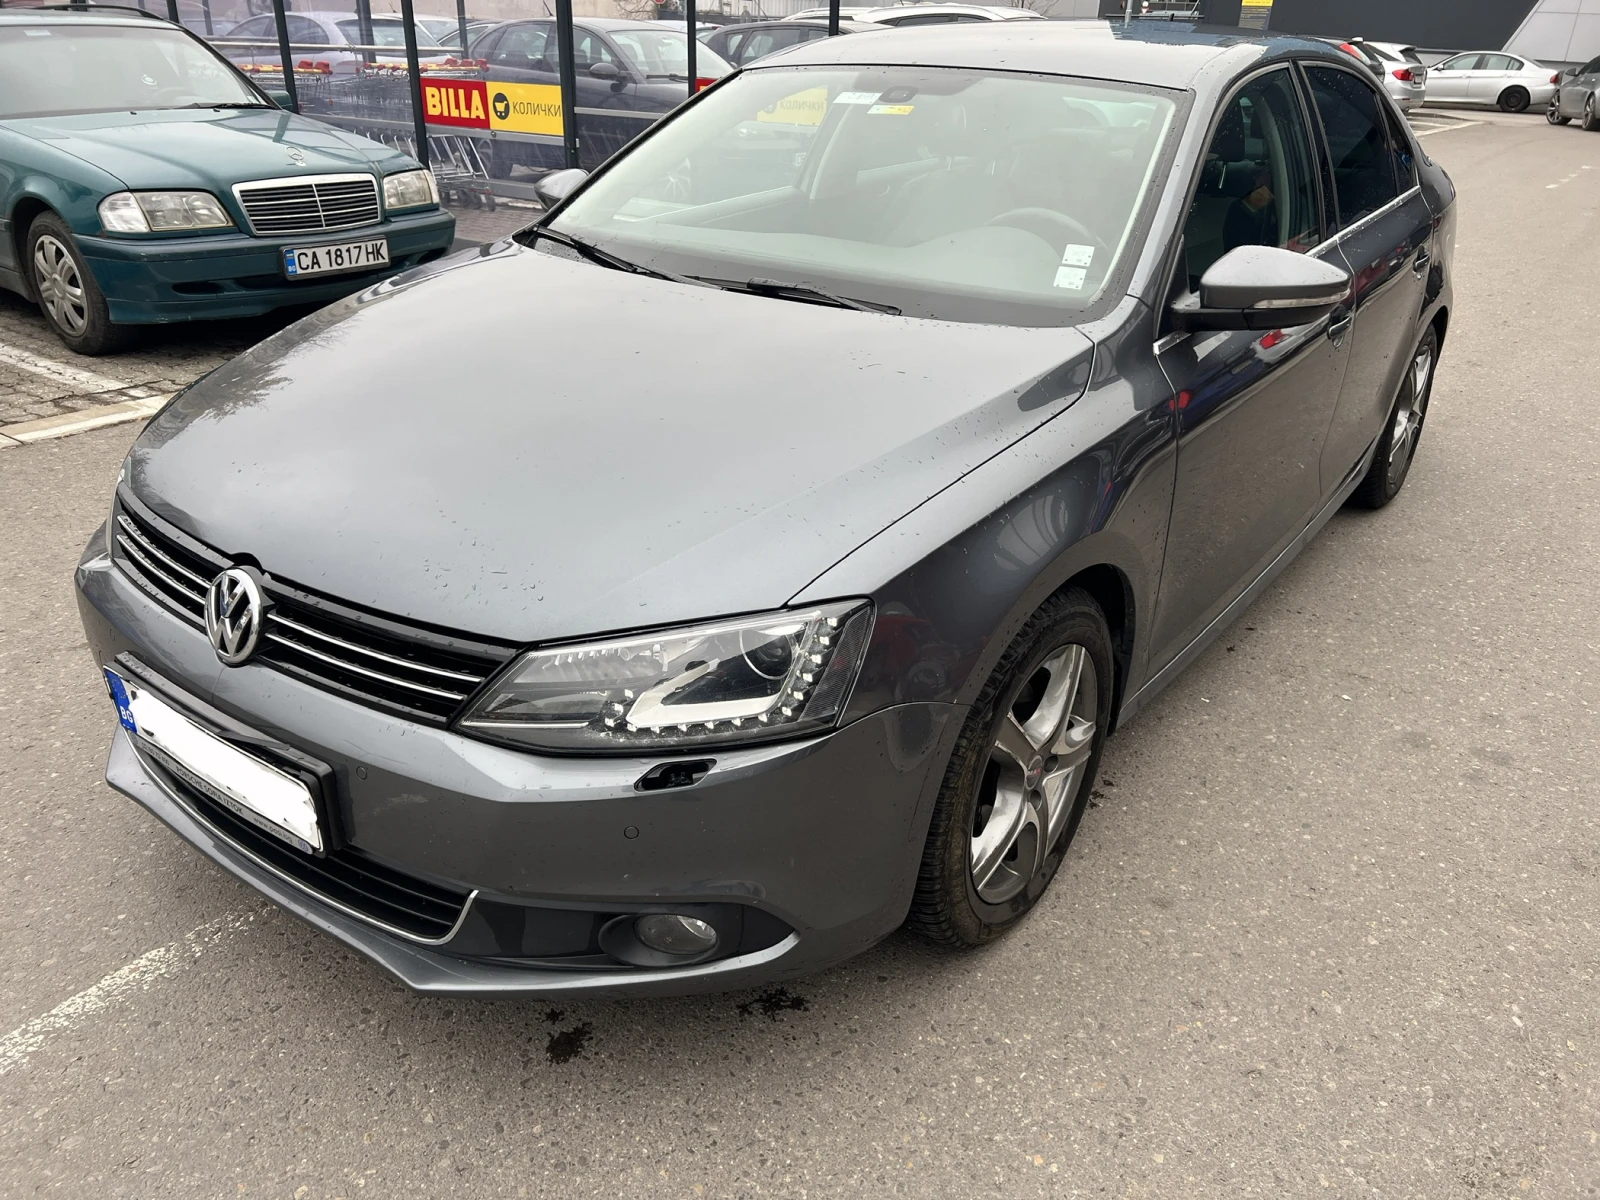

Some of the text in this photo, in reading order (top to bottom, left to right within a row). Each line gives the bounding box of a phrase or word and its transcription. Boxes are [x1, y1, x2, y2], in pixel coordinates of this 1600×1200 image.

[425, 86, 486, 120] BILLA
[512, 101, 562, 117] КОЛИЧКИ
[297, 242, 386, 270] CA 1817 HK
[119, 705, 134, 724] BG
[175, 765, 204, 790] PORSCHE
